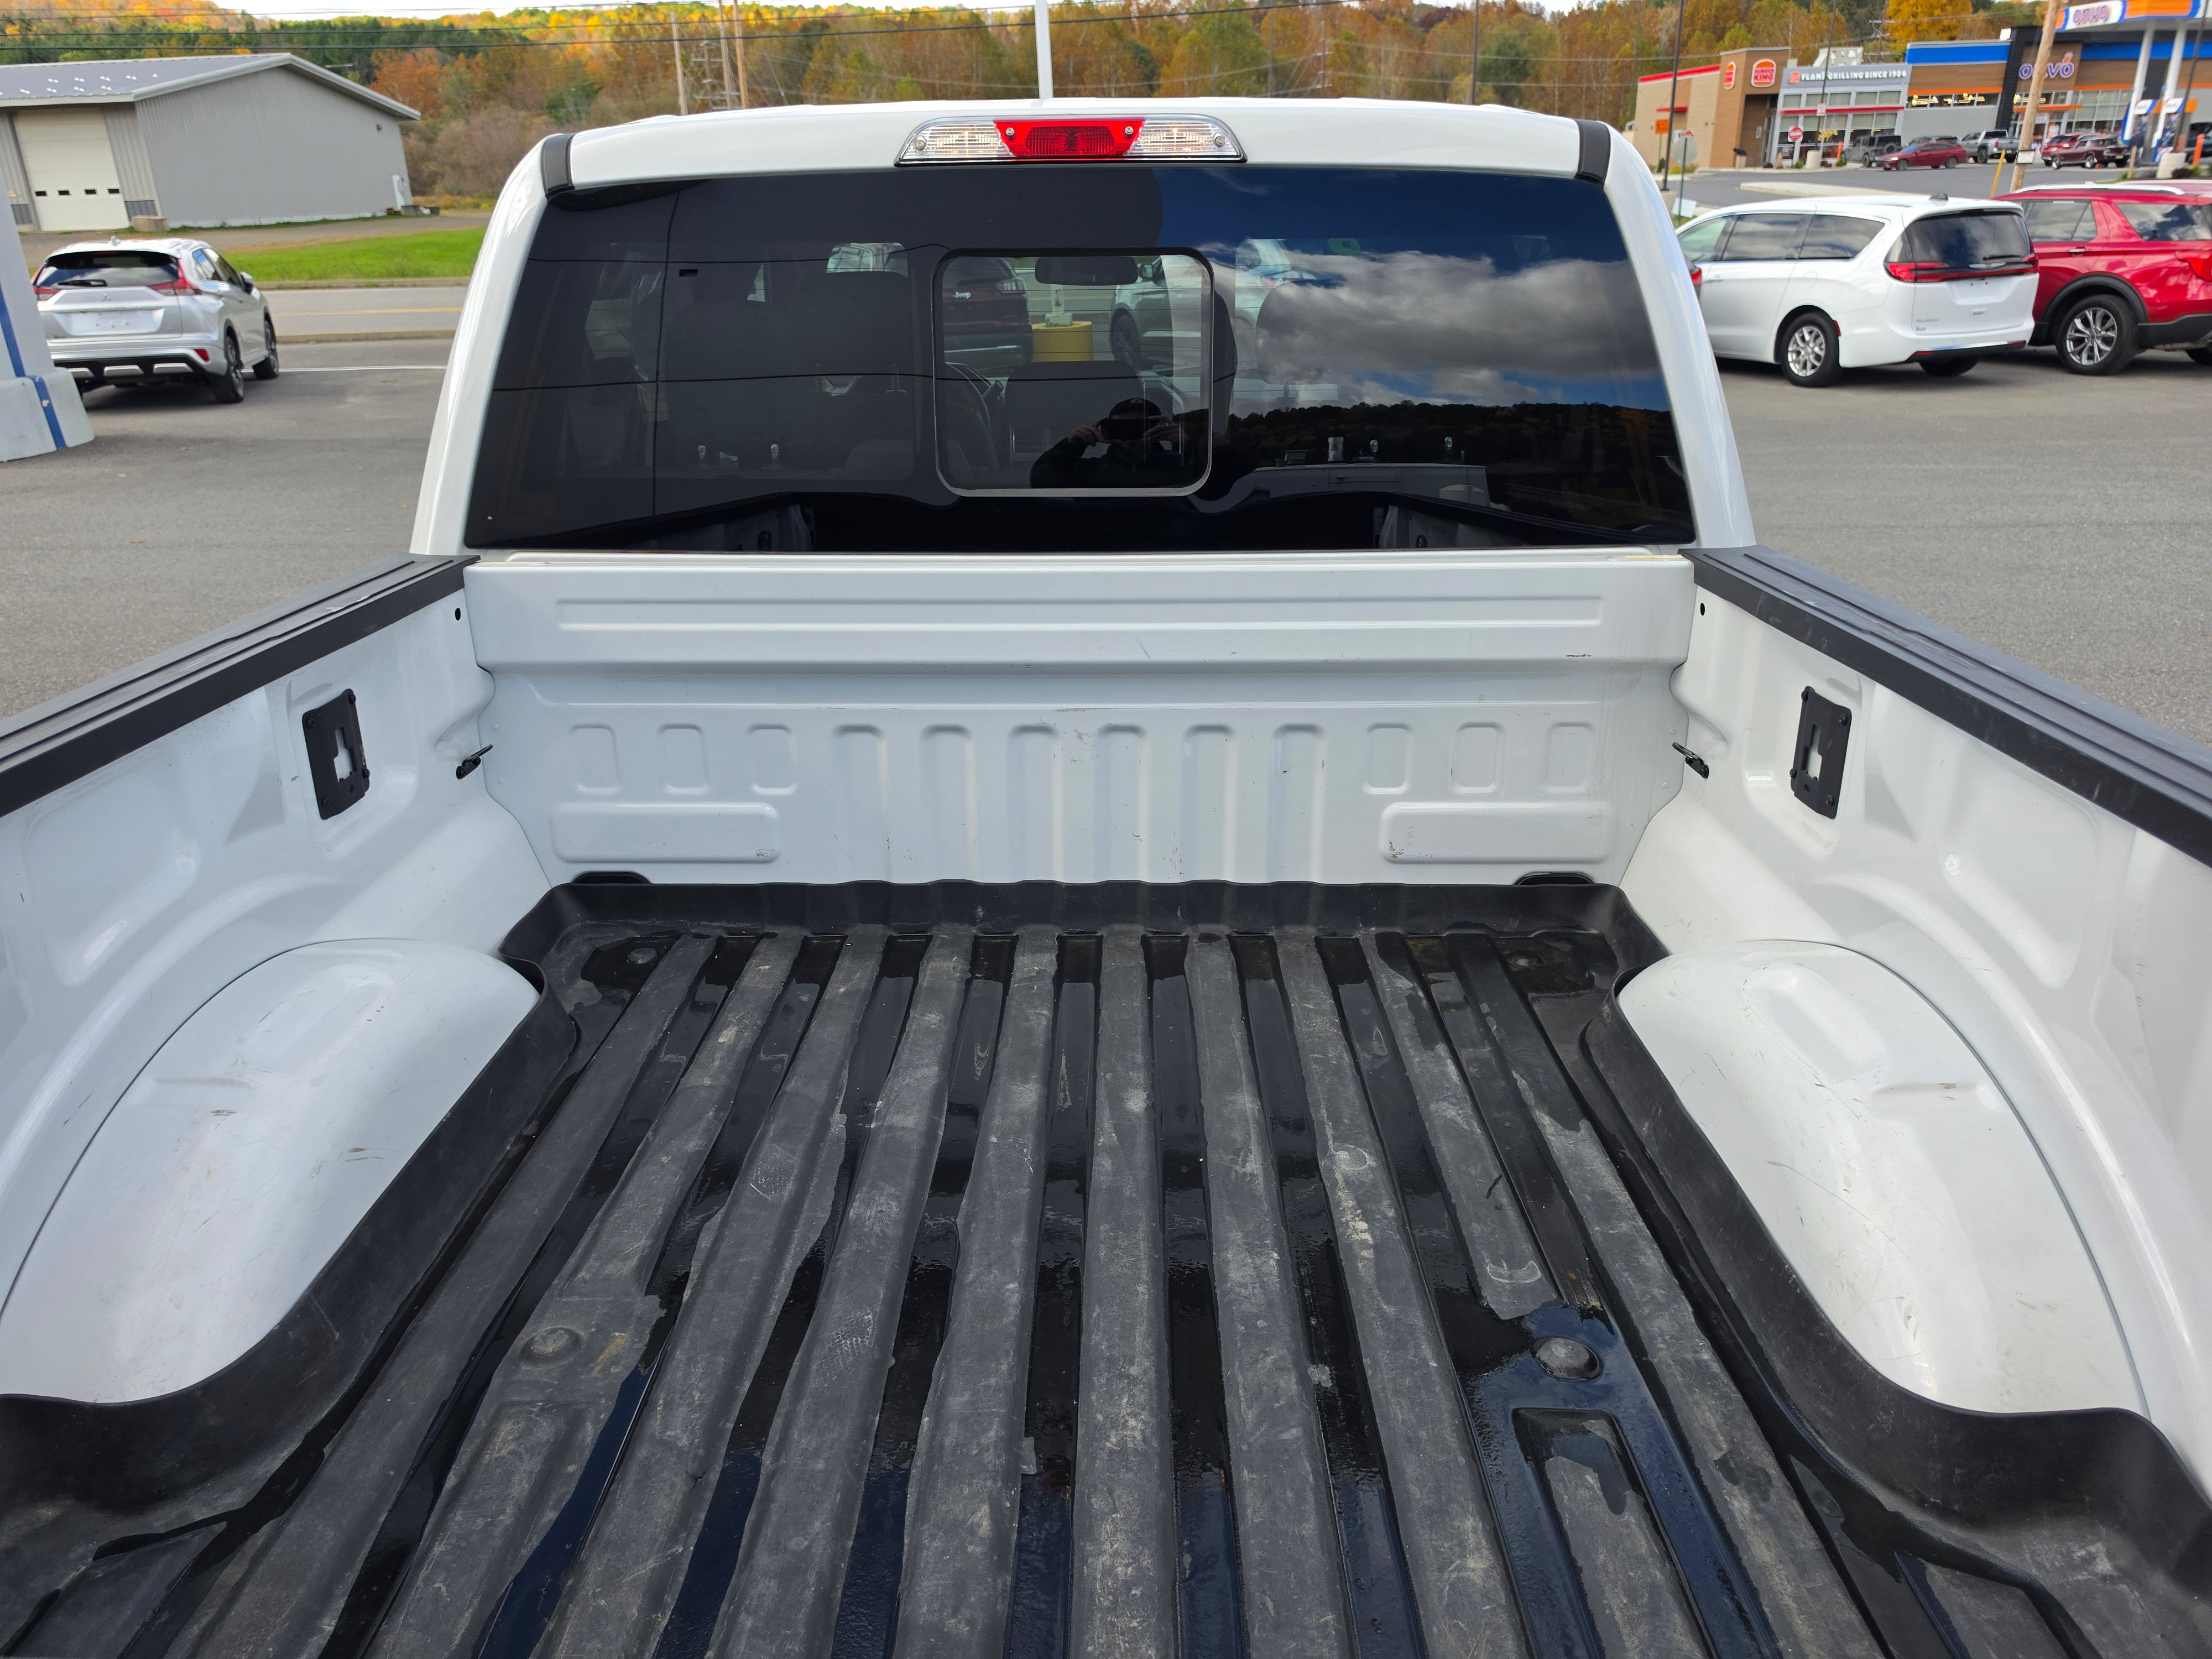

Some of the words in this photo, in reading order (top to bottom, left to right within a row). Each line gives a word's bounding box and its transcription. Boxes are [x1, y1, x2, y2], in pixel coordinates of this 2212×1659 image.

[2073, 5, 2108, 24] onvo
[1864, 70, 1888, 79] SINCE
[1888, 70, 1907, 78] 1954
[2018, 61, 2074, 80] ovo
